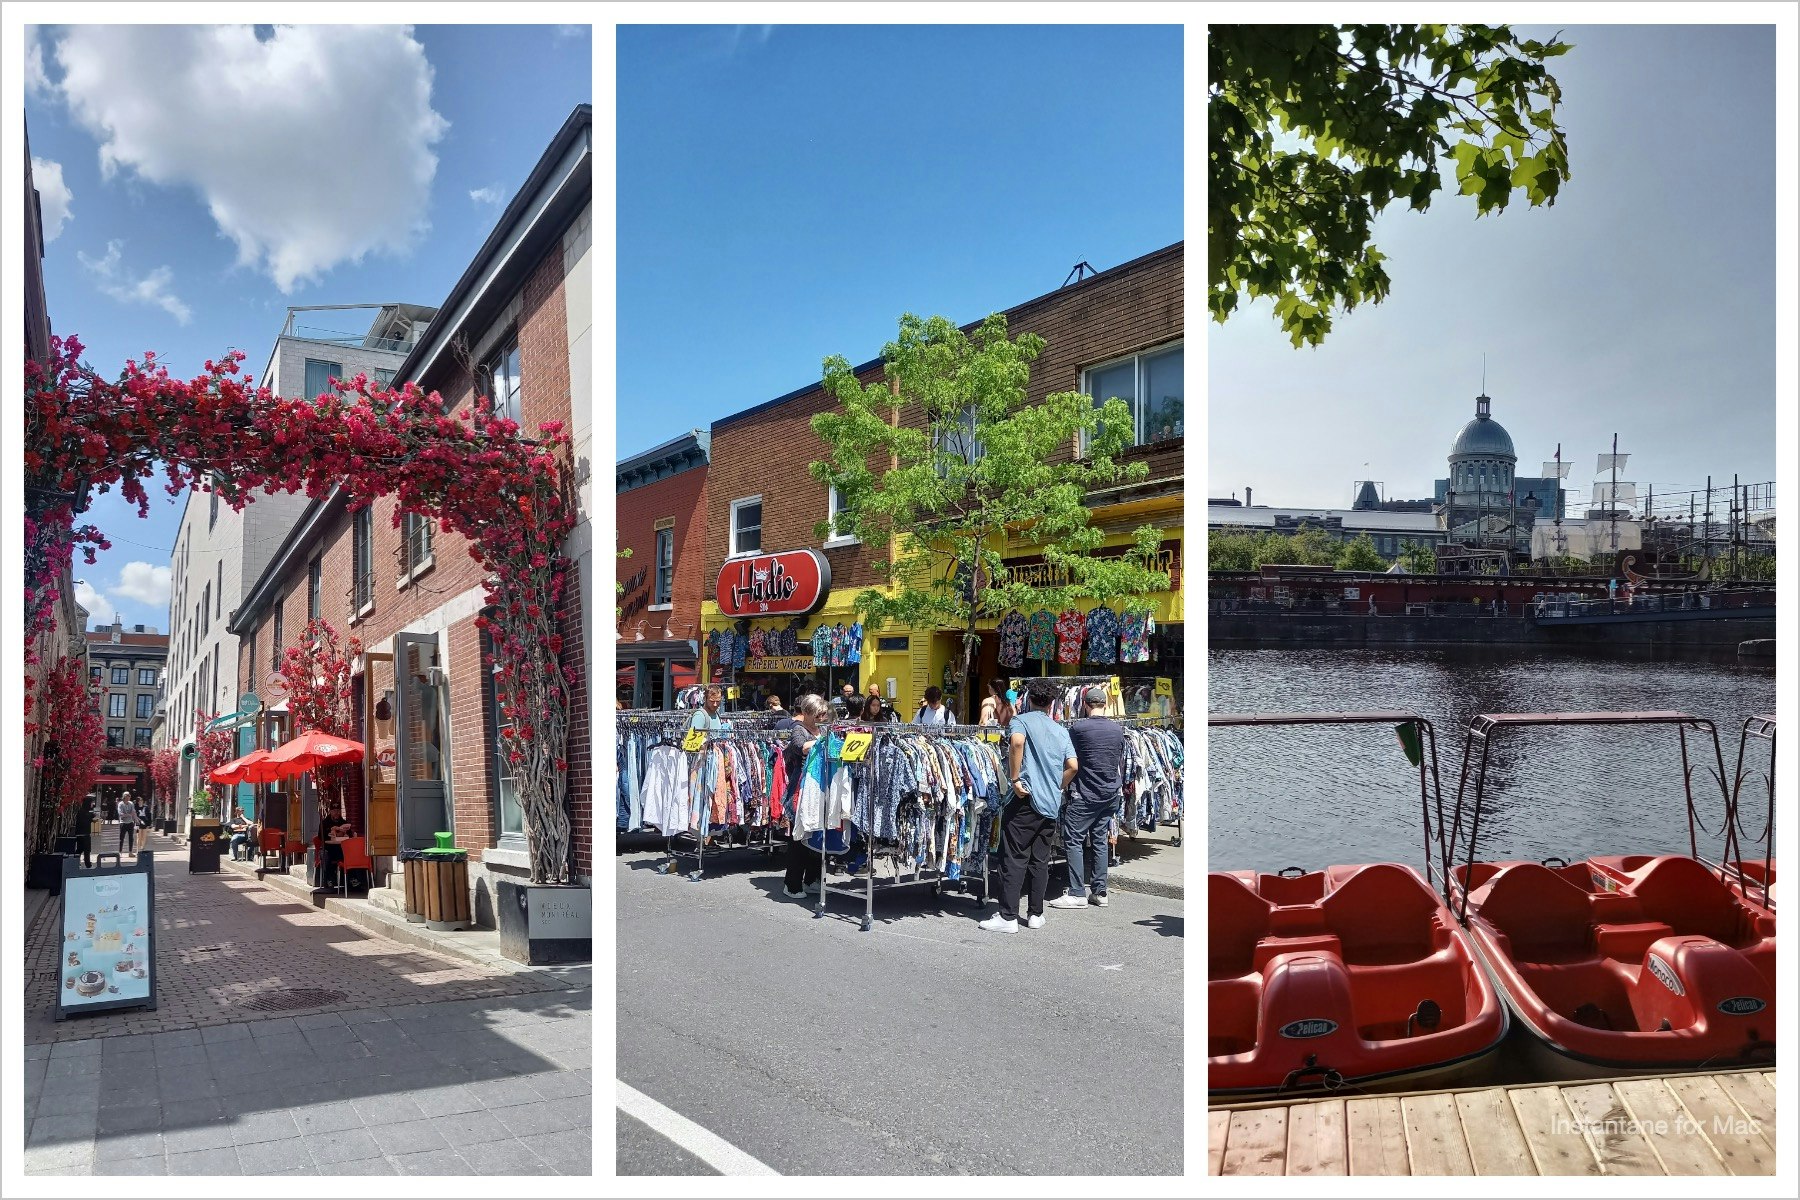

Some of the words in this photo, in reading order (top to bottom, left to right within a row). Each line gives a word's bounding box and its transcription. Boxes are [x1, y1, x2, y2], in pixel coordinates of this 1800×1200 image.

[731, 557, 799, 612] Hadio
[1730, 999, 1759, 1012] Pelican
[1297, 1021, 1328, 1035] Pelican
